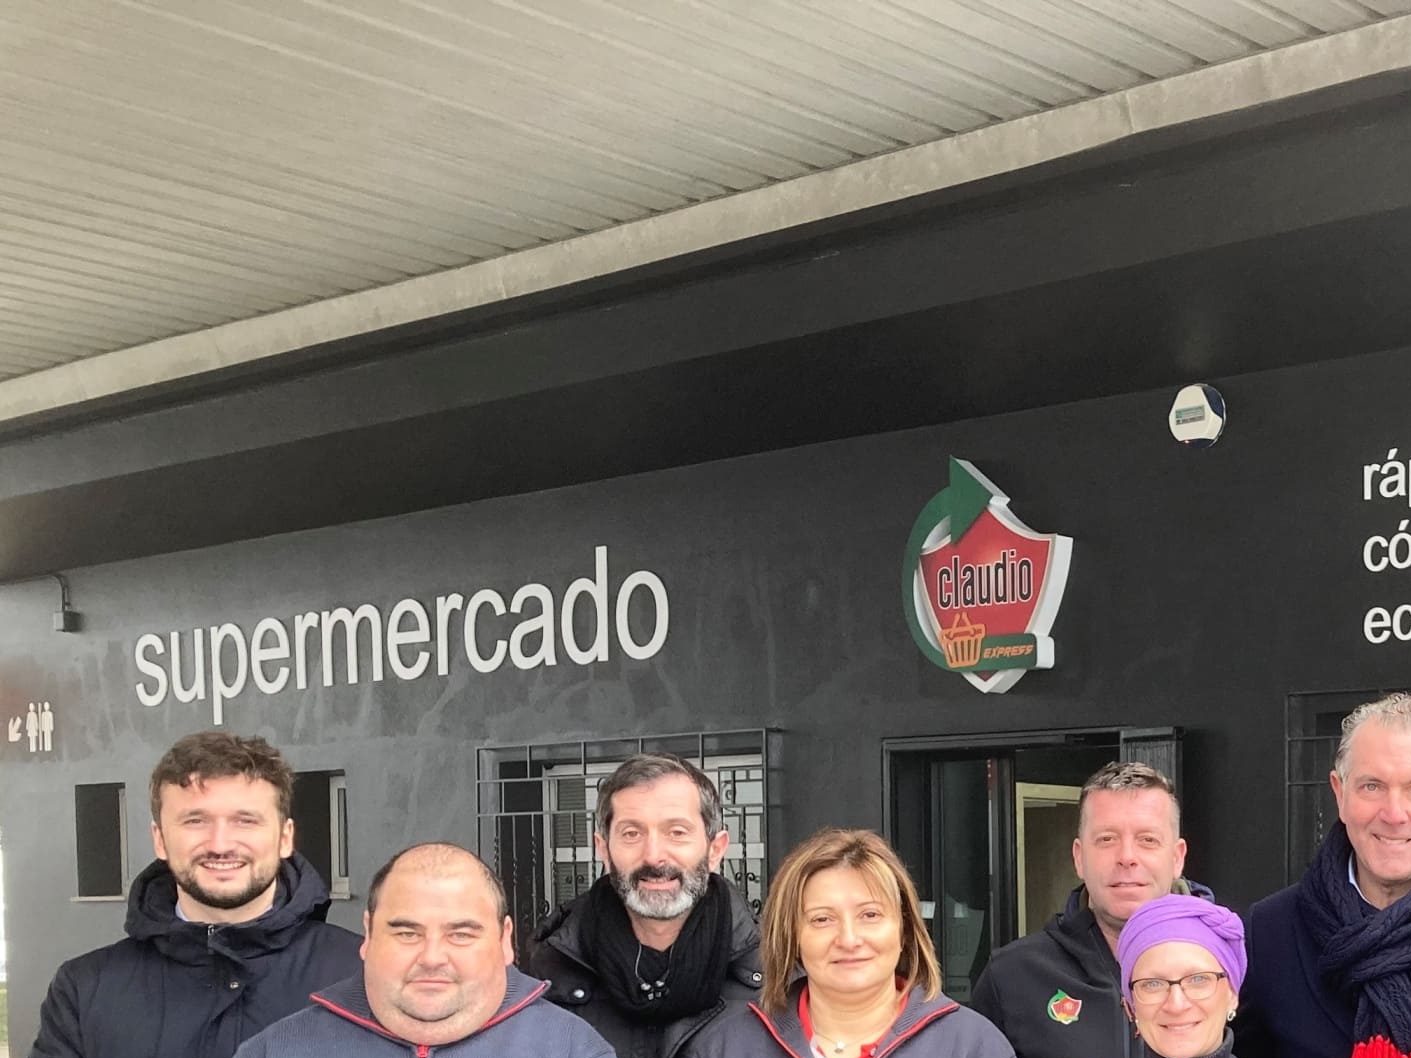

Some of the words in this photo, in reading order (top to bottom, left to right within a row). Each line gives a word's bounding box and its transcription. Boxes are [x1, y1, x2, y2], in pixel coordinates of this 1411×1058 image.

[936, 549, 1033, 609] claudio
[134, 545, 670, 726] supermercado
[983, 645, 1034, 658] EXPRESS
